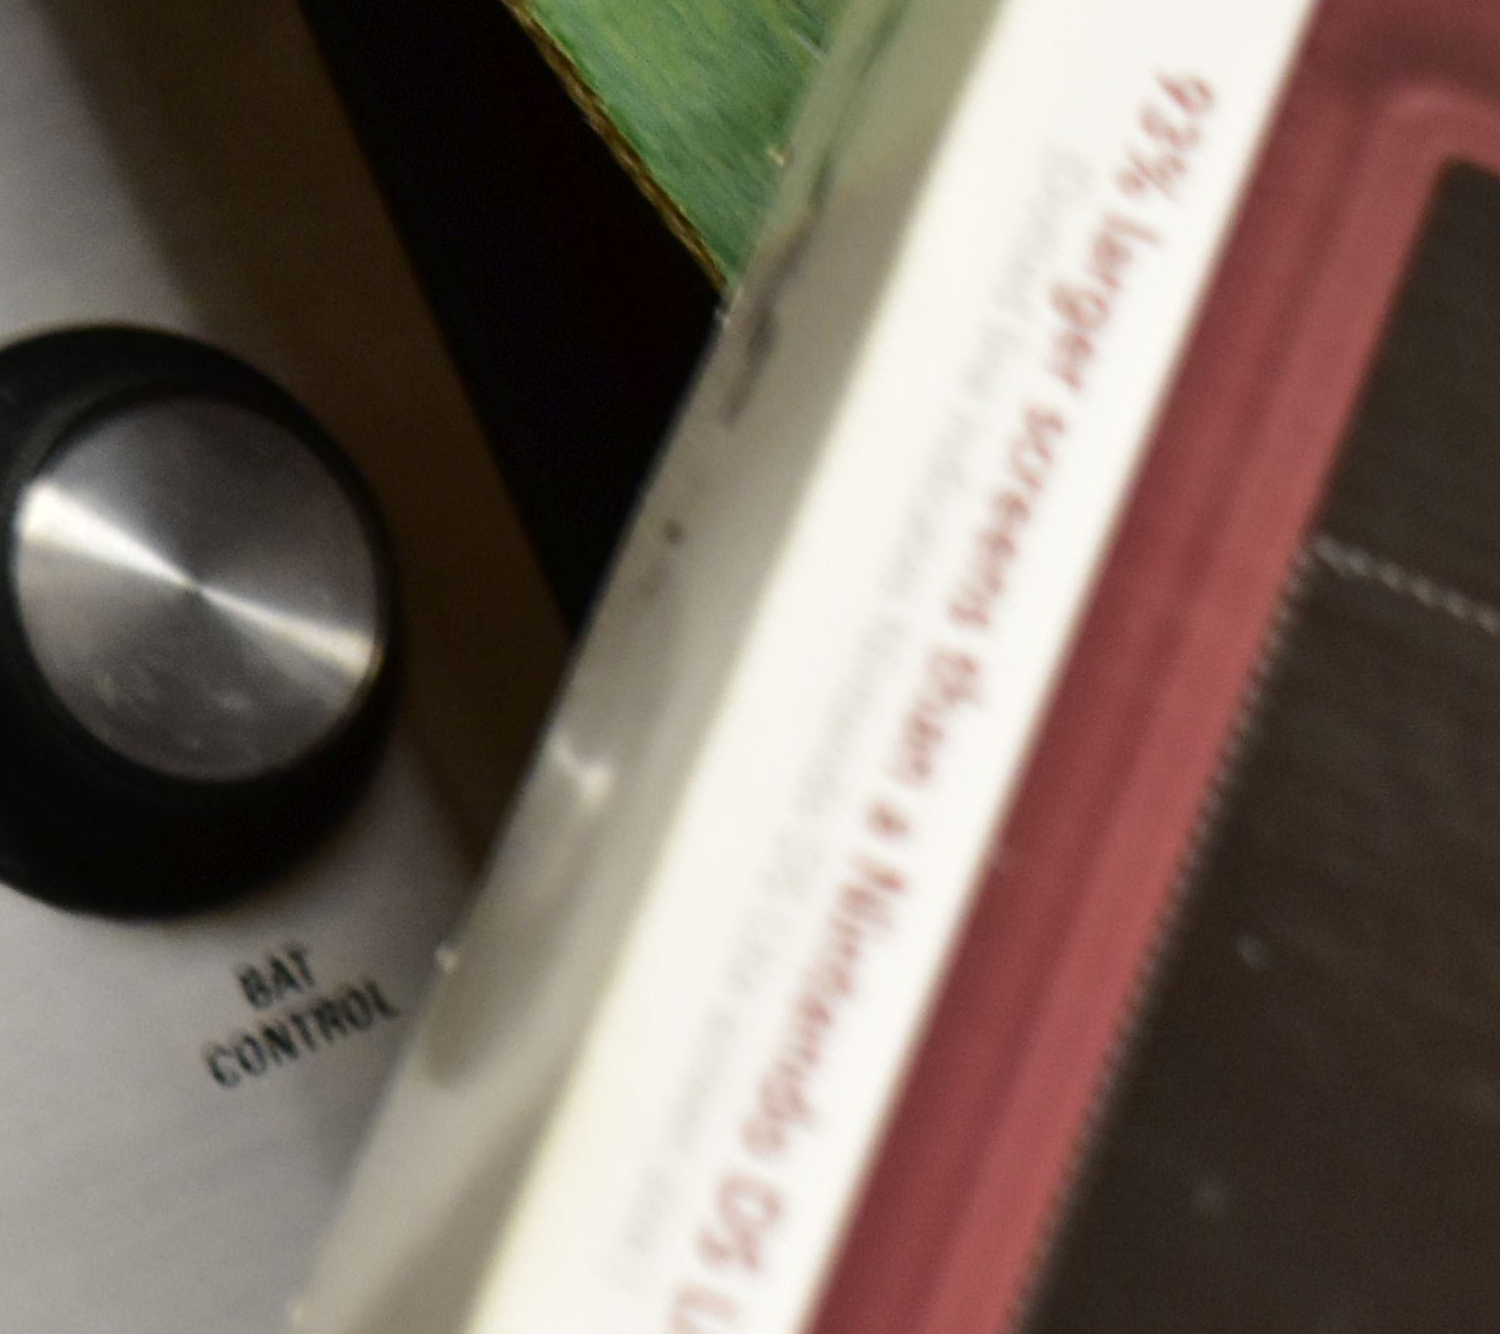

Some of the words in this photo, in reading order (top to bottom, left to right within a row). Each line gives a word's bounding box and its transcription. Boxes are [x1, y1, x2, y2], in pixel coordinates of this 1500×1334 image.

[1115, 74, 1216, 197] 93%
[1047, 212, 1159, 394] larger
[946, 405, 1068, 631] screens
[890, 647, 982, 788] than
[865, 800, 910, 841] a
[203, 975, 400, 1090] CONTROL
[234, 941, 315, 1011] BAT
[740, 855, 908, 1159] Nintendo
[695, 1171, 785, 1275] DS
